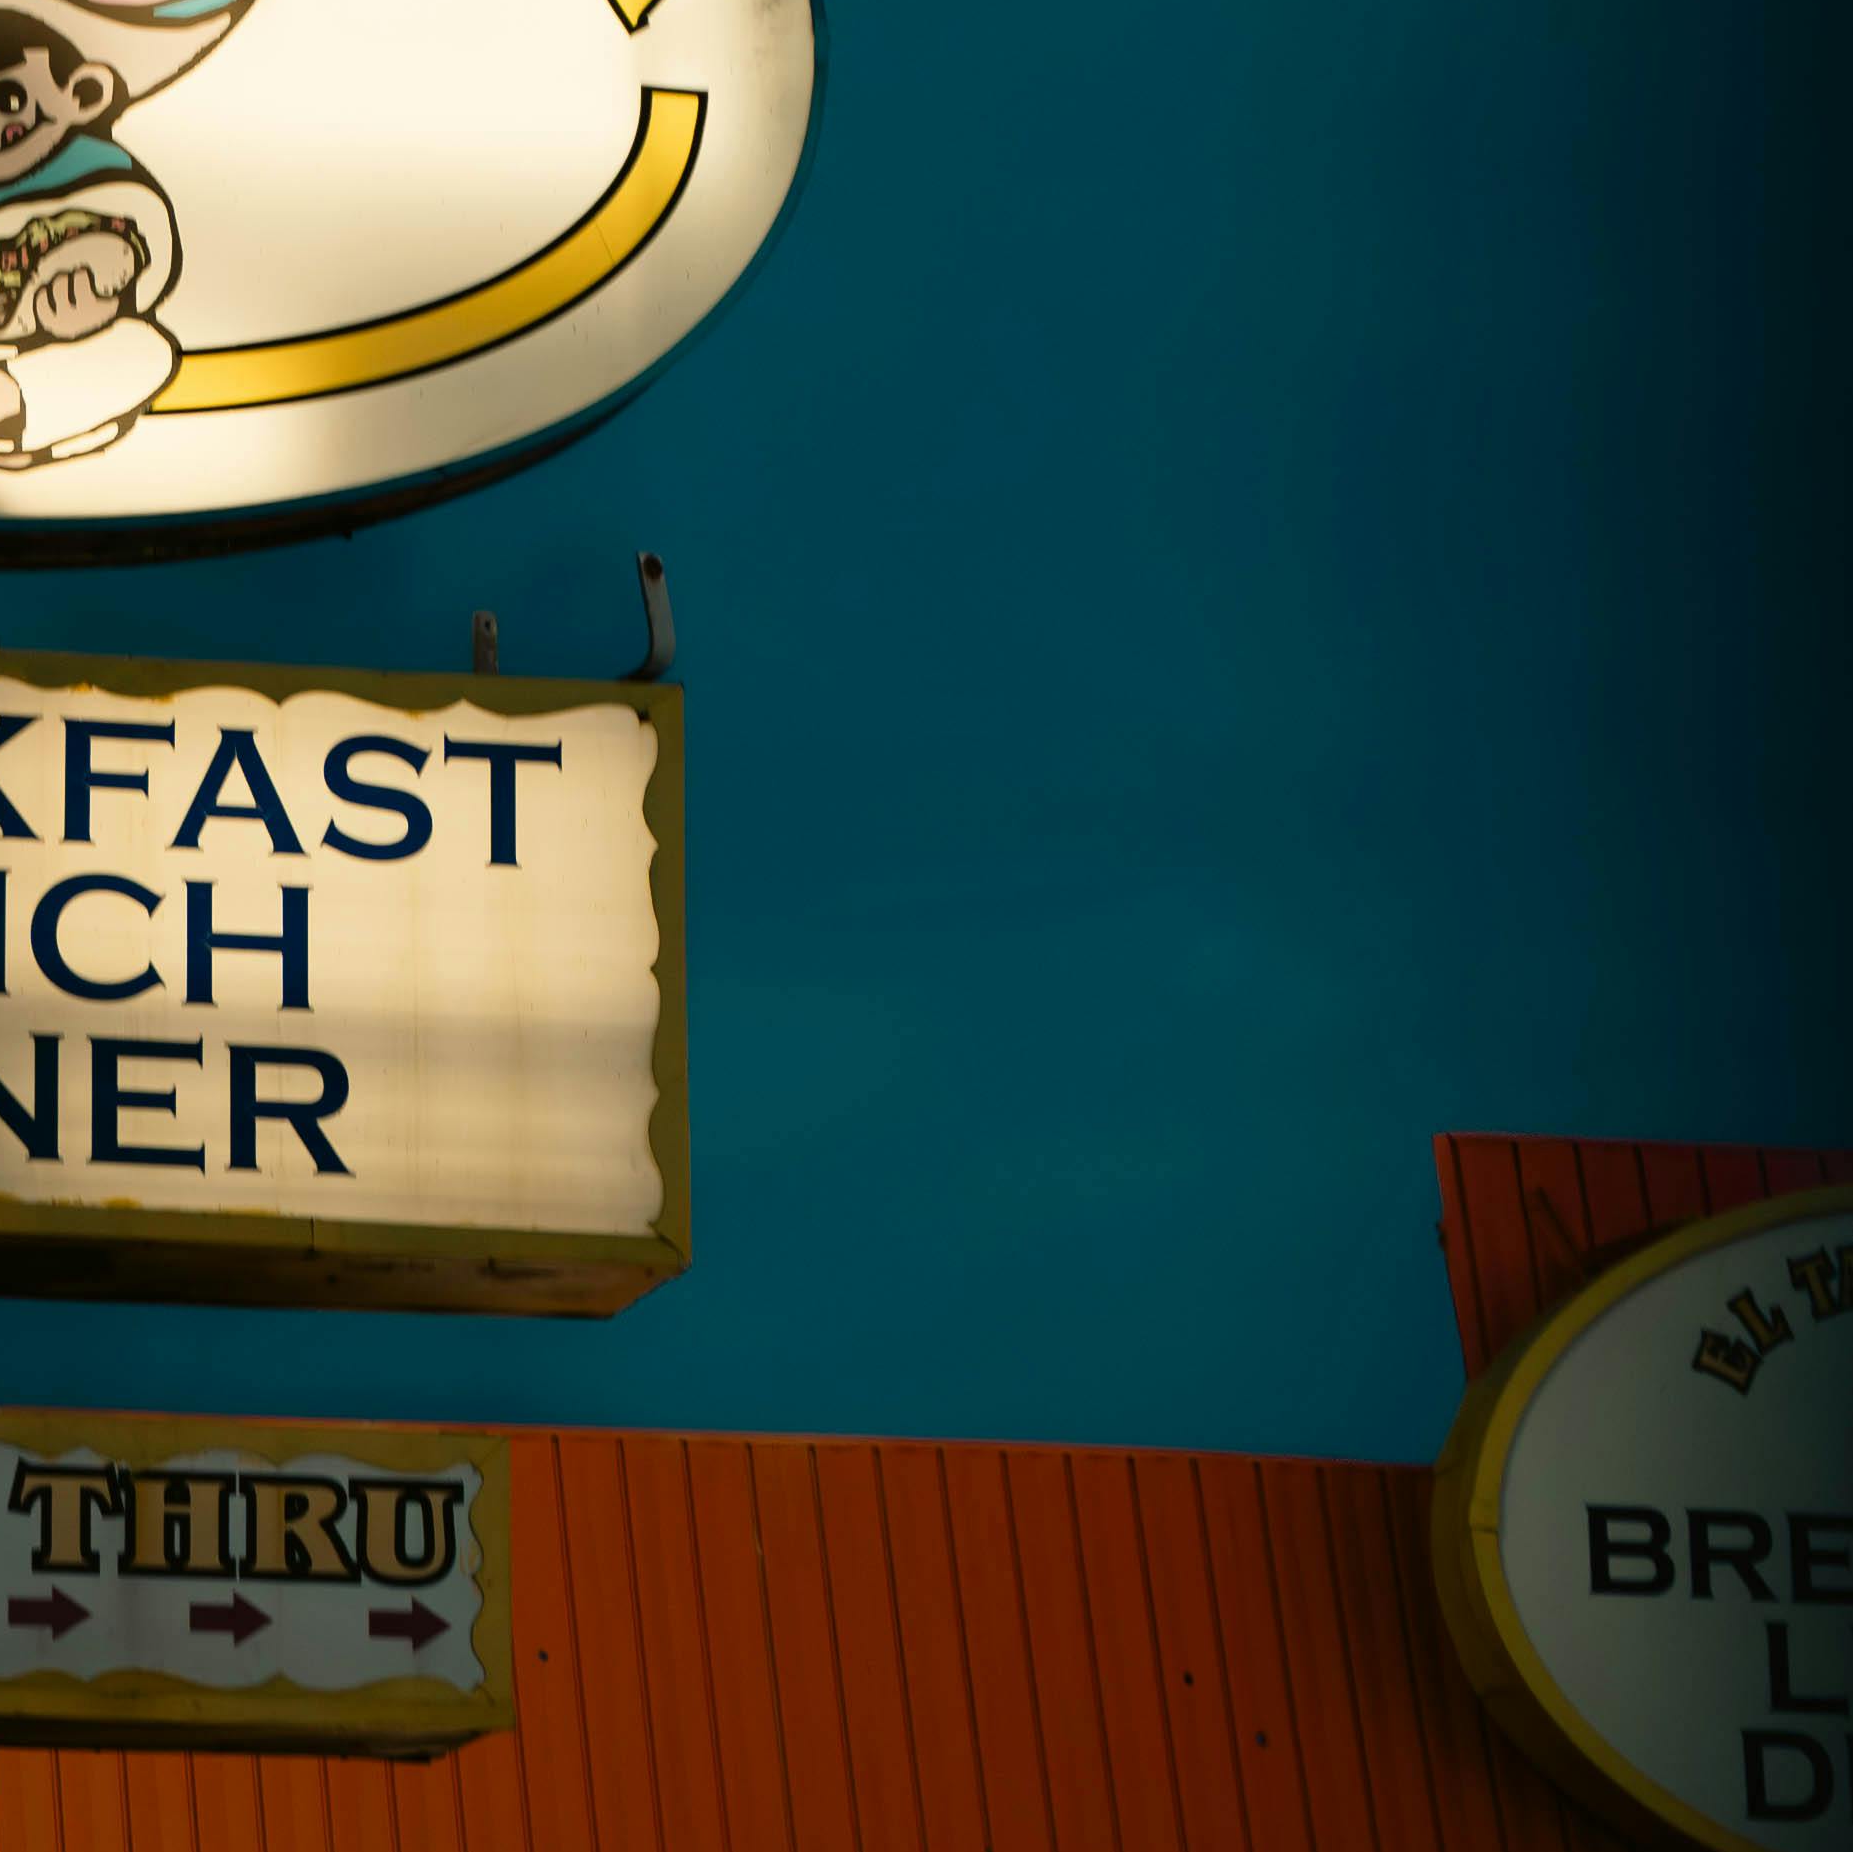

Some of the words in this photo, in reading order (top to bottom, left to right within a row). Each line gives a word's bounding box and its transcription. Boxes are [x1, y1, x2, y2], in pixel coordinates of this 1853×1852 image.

[1692, 1285, 1794, 1396] EL
[8, 1457, 464, 1588] THRU
[1764, 1618, 1853, 1714] L
[1740, 1727, 1853, 1822] D
